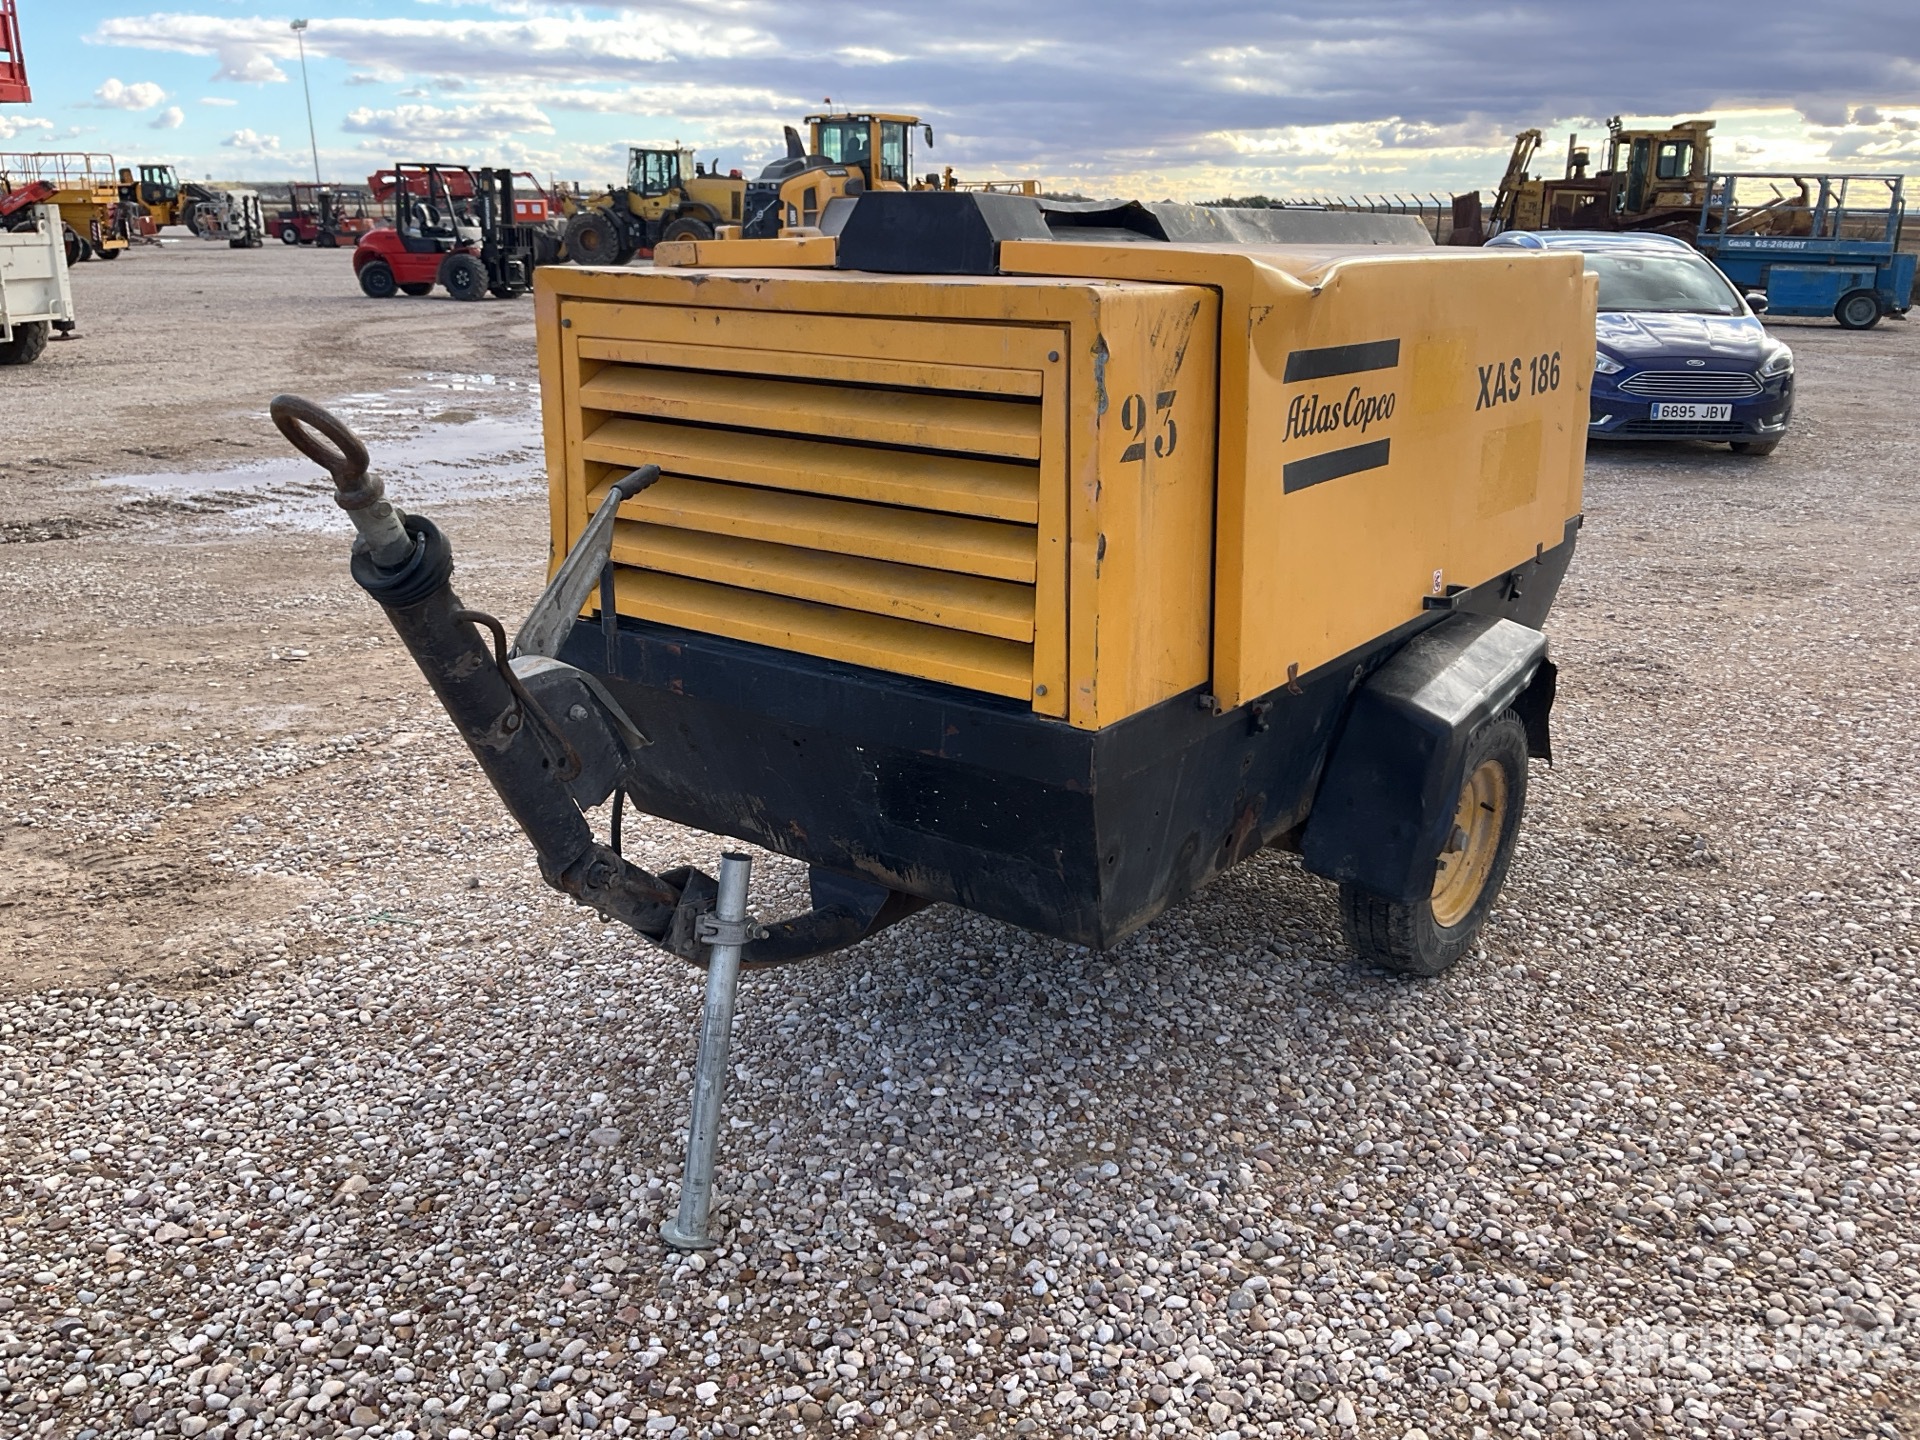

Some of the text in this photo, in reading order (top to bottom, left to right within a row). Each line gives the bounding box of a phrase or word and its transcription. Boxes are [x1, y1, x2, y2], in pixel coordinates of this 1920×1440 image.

[1728, 240, 1751, 248] Genie
[1475, 351, 1561, 412] XAS 186
[1119, 390, 1178, 463] 23
[1282, 386, 1396, 443] Atlas Copco
[1661, 405, 1696, 418] 6895
[1701, 406, 1728, 419] JBV
